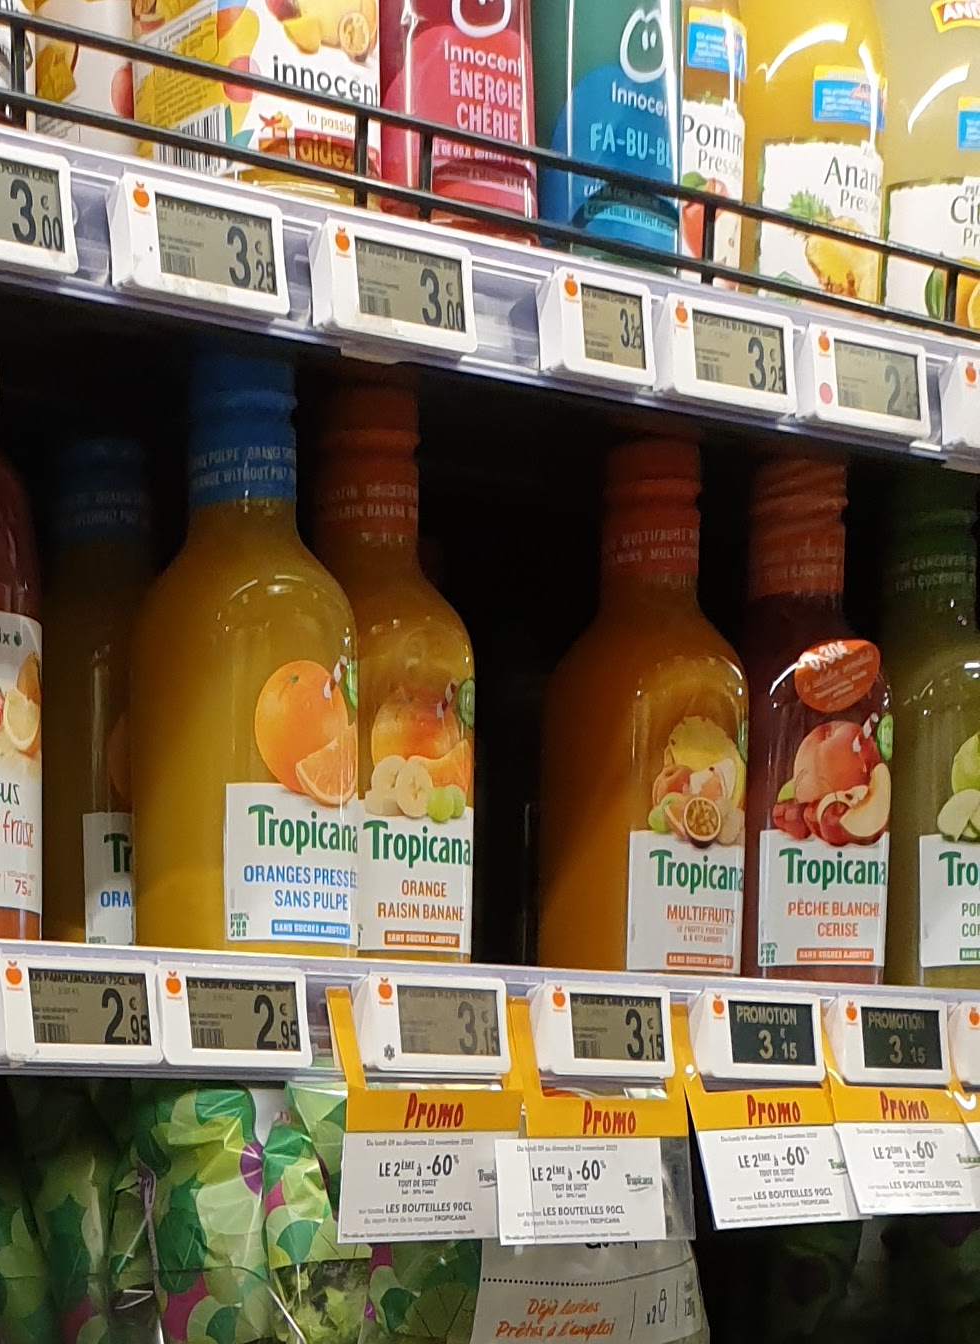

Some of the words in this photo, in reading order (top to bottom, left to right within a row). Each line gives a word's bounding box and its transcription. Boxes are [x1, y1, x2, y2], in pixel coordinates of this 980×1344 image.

[456, 98, 519, 142] CHÉRIE
[363, 820, 471, 868] Tropicana
[243, 864, 311, 883] ORANGES
[779, 848, 886, 890] Tropicana
[401, 879, 447, 898] ORANGE
[274, 889, 311, 908] SANS
[313, 891, 348, 912] PULPE
[378, 902, 420, 919] RAISIN
[422, 904, 464, 922] BANANE
[667, 905, 735, 923] MULTIFRUITS
[817, 922, 859, 937] CERISE
[736, 1005, 798, 1026] PROMOTION
[404, 1092, 464, 1130] Promo
[747, 1093, 801, 1127] Promo
[880, 1090, 930, 1121] Promo
[582, 1100, 637, 1135] Promo
[403, 1202, 451, 1214] BOUTEILLES
[558, 1205, 604, 1216] BOUTEILLES
